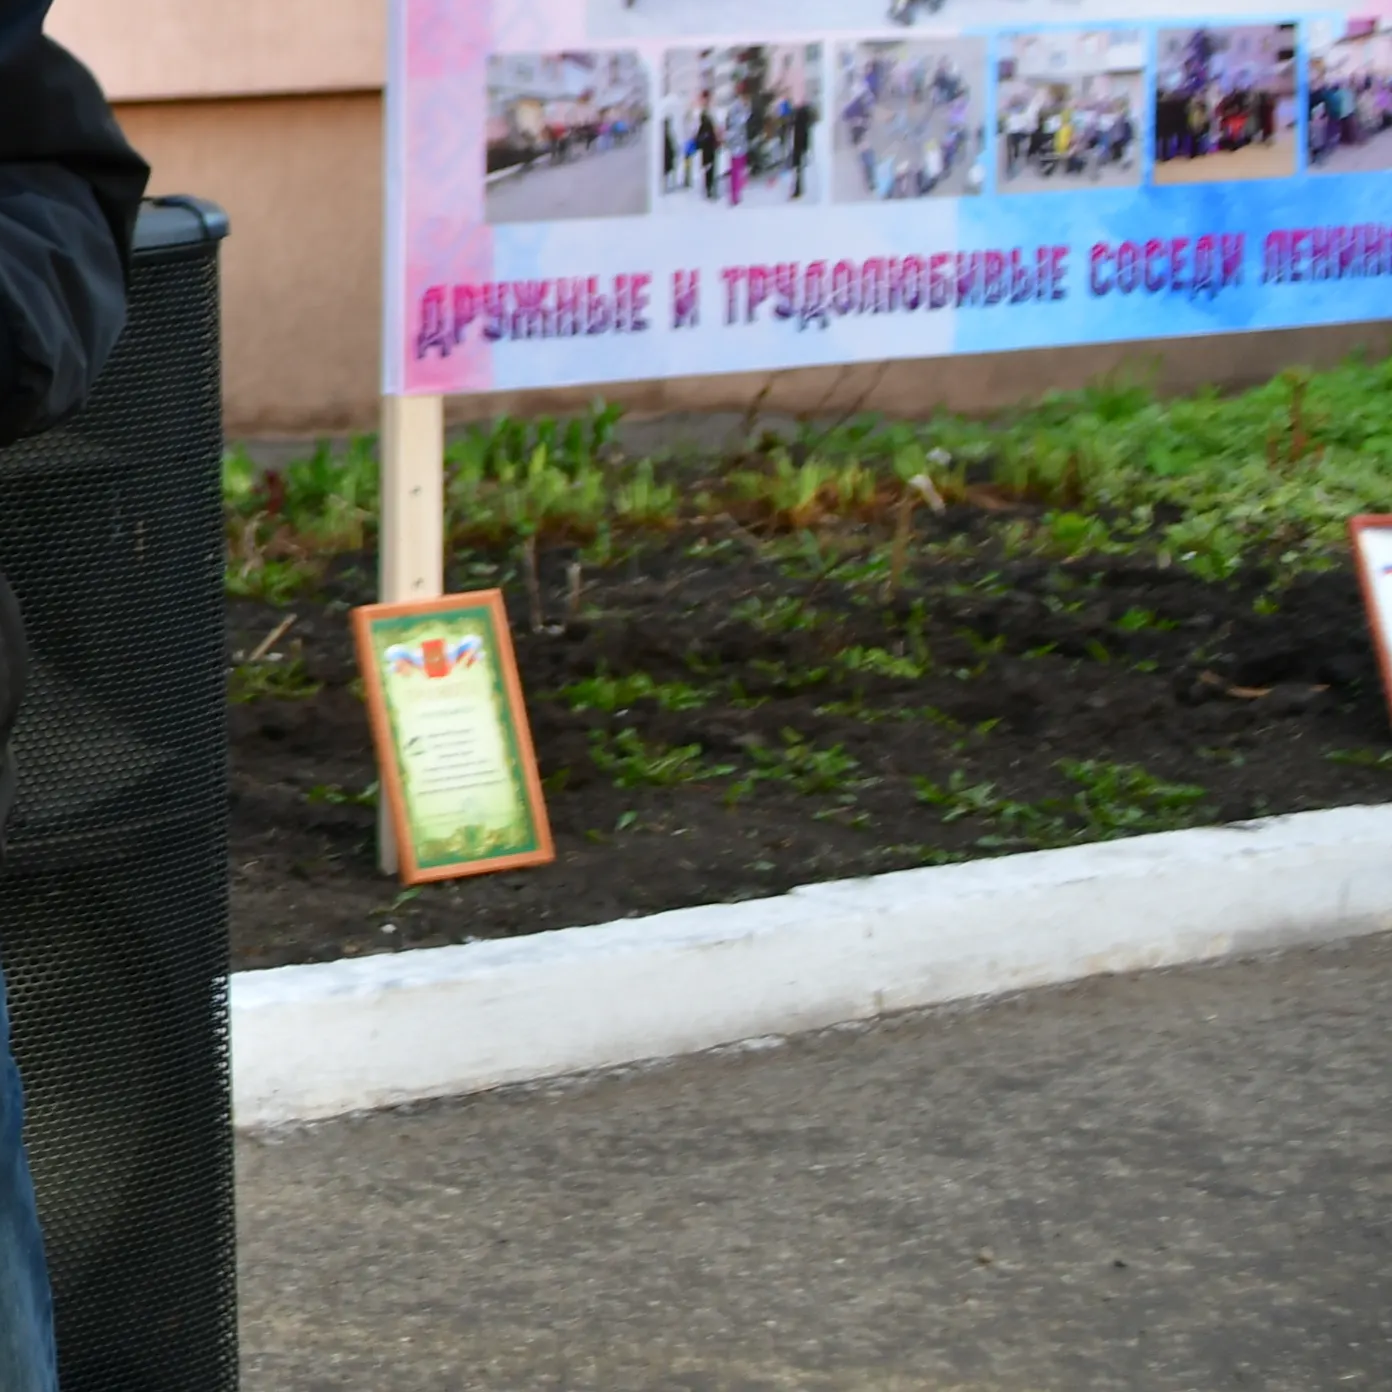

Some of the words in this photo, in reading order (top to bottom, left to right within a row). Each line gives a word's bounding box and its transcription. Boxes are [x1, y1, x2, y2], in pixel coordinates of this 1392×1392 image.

[414, 272, 652, 360] ДРУЖНЫЕ
[672, 268, 700, 330] И
[721, 243, 1071, 331] ТРУДОЛЮБИВЫЕ
[1089, 232, 1246, 300] СОСЕДИ
[1261, 221, 1392, 286] ЛЕНИН
